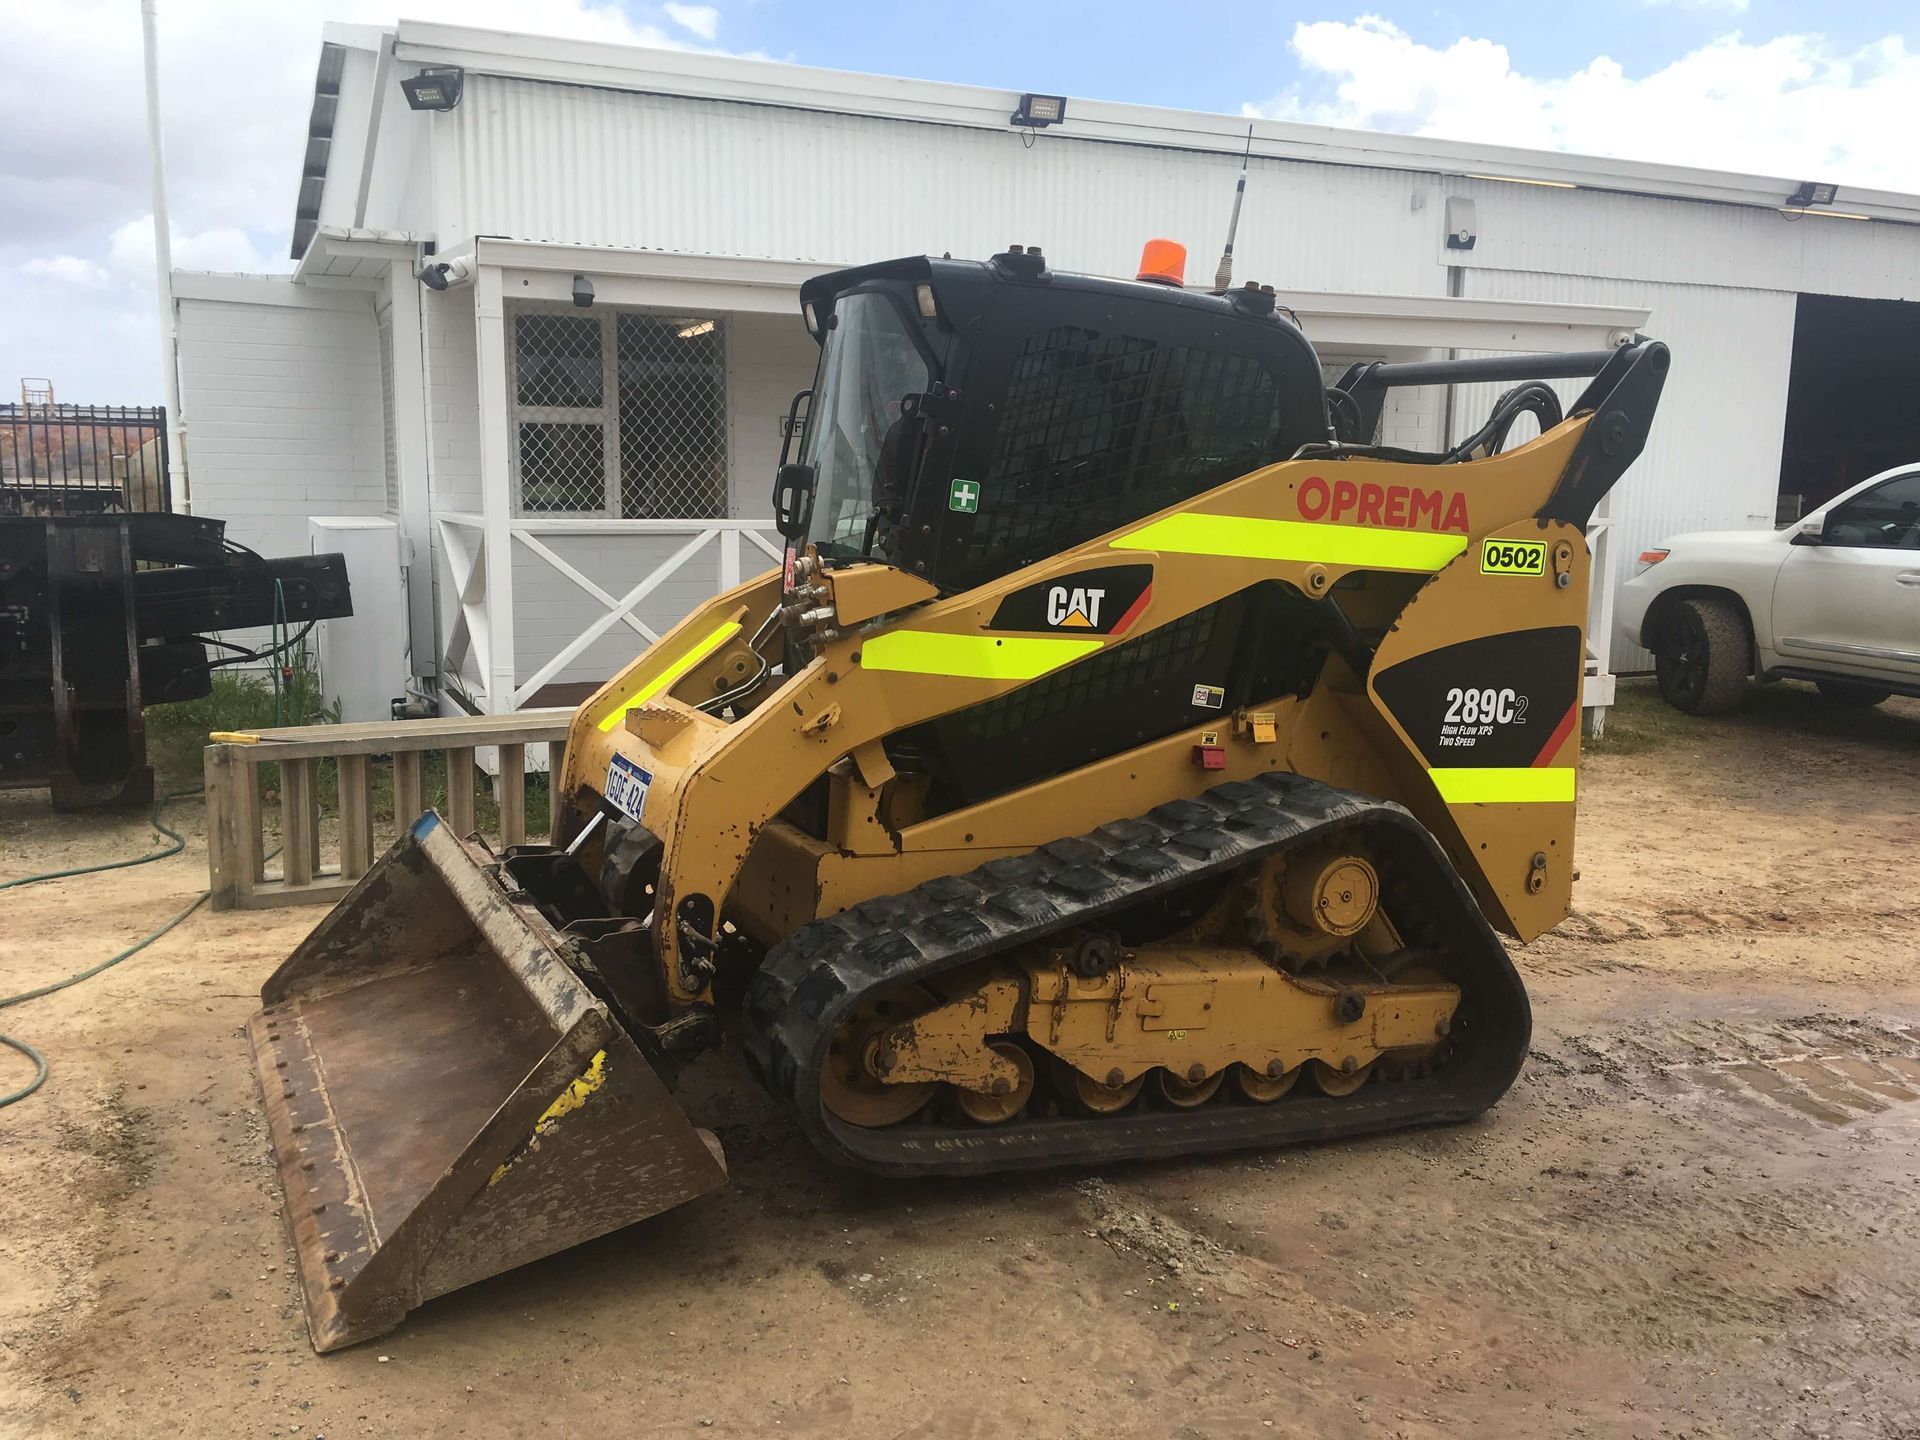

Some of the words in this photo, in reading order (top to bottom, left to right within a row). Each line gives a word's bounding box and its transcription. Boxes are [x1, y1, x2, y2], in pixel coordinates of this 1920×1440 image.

[1297, 476, 1469, 533] OPREMA
[1486, 545, 1541, 569] 0502
[1047, 586, 1105, 628] CAT
[1477, 725, 1494, 736] XPS
